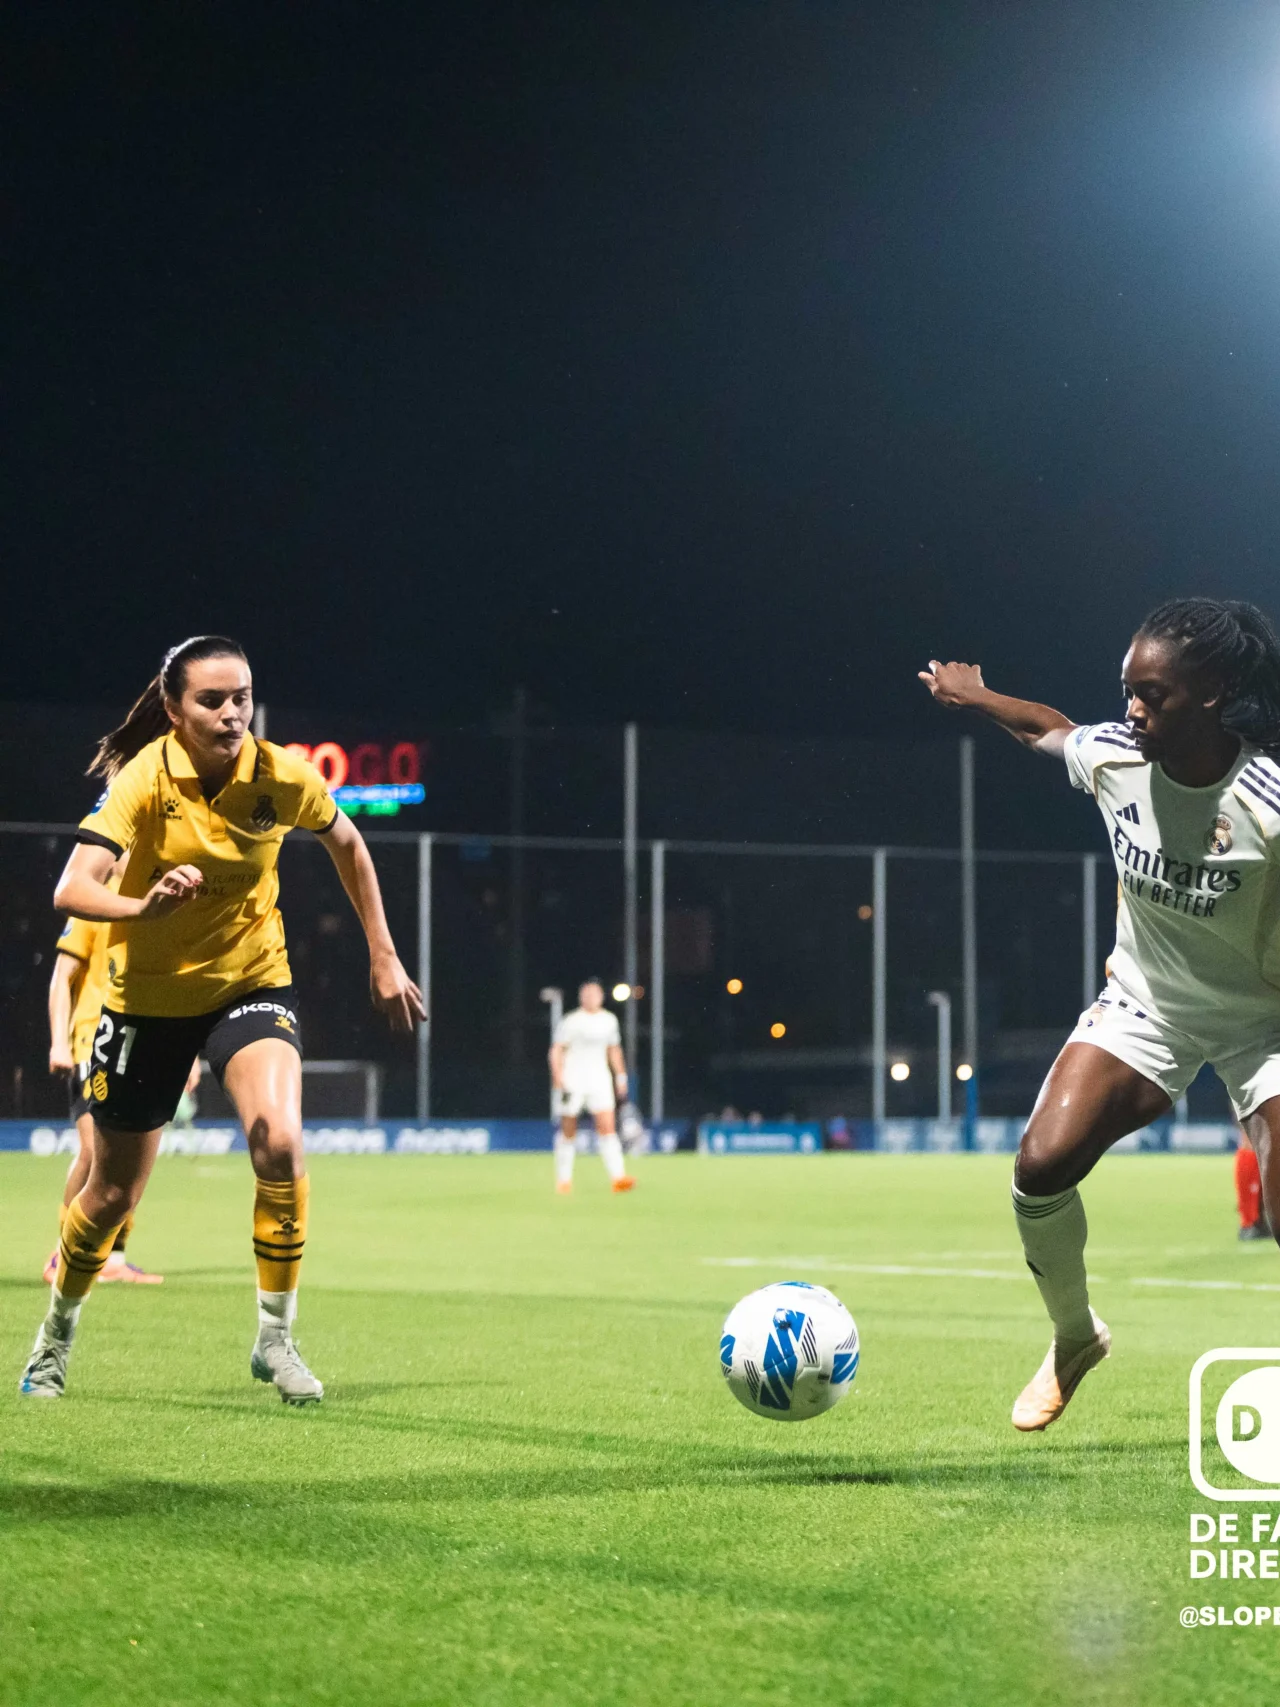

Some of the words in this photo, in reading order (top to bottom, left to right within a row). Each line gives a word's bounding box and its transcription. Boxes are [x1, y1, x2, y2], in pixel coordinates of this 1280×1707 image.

[1113, 826, 1242, 893] Emirates
[1123, 868, 1145, 898] FLY
[1151, 885, 1217, 918] BETTER
[228, 1002, 297, 1024] SKODA
[94, 1013, 137, 1076] 21
